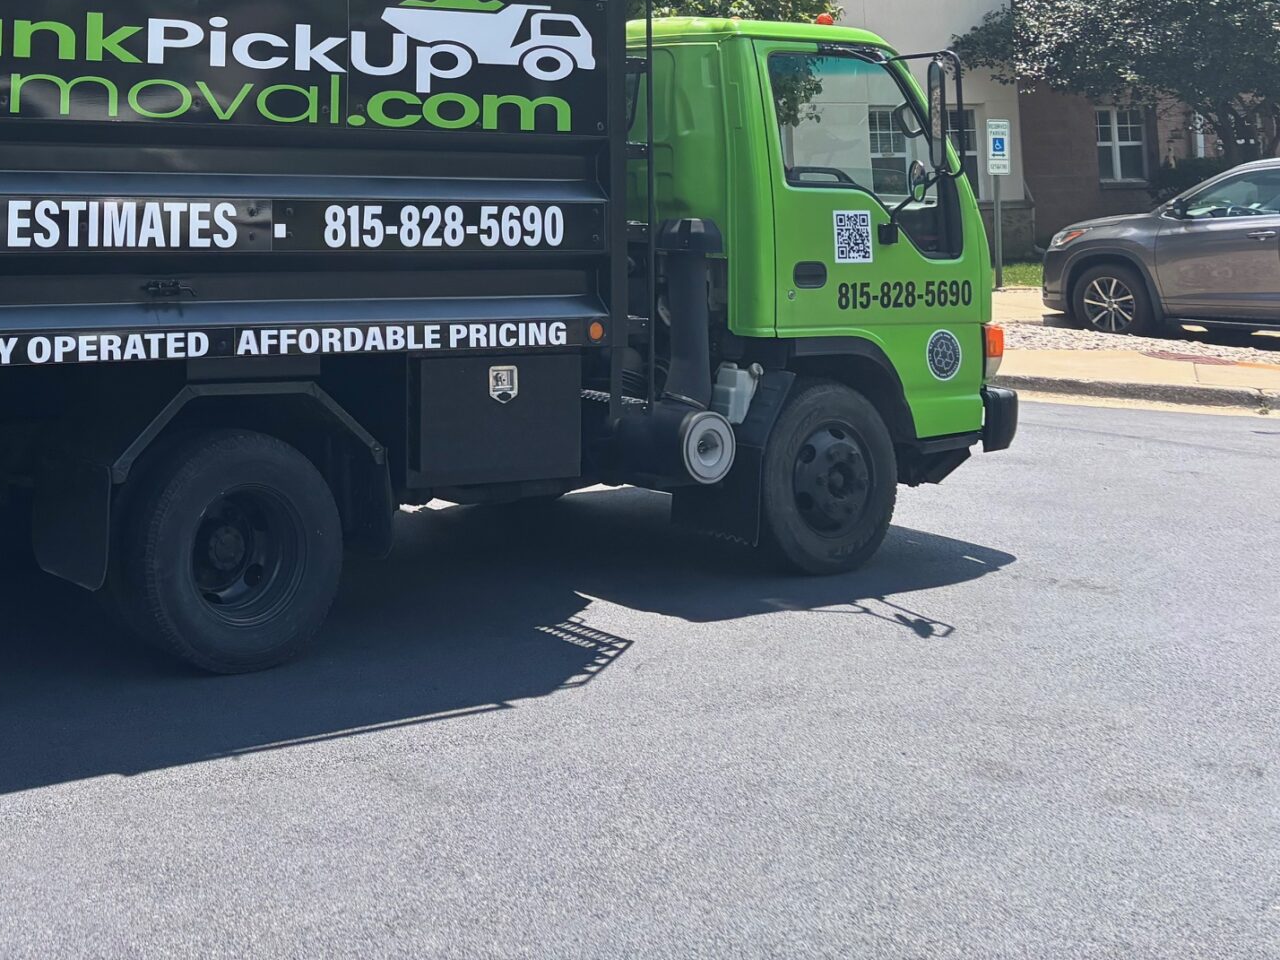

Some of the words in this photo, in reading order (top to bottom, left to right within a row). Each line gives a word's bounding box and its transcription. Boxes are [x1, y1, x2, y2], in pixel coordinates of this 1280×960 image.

[7, 201, 238, 248] ESTIMATES
[323, 205, 566, 248] 815-828-5690
[837, 279, 972, 310] 815-828-5690
[27, 331, 210, 363] OPERATED
[236, 325, 442, 356] AFFORDABLE
[448, 320, 568, 349] PRICING
